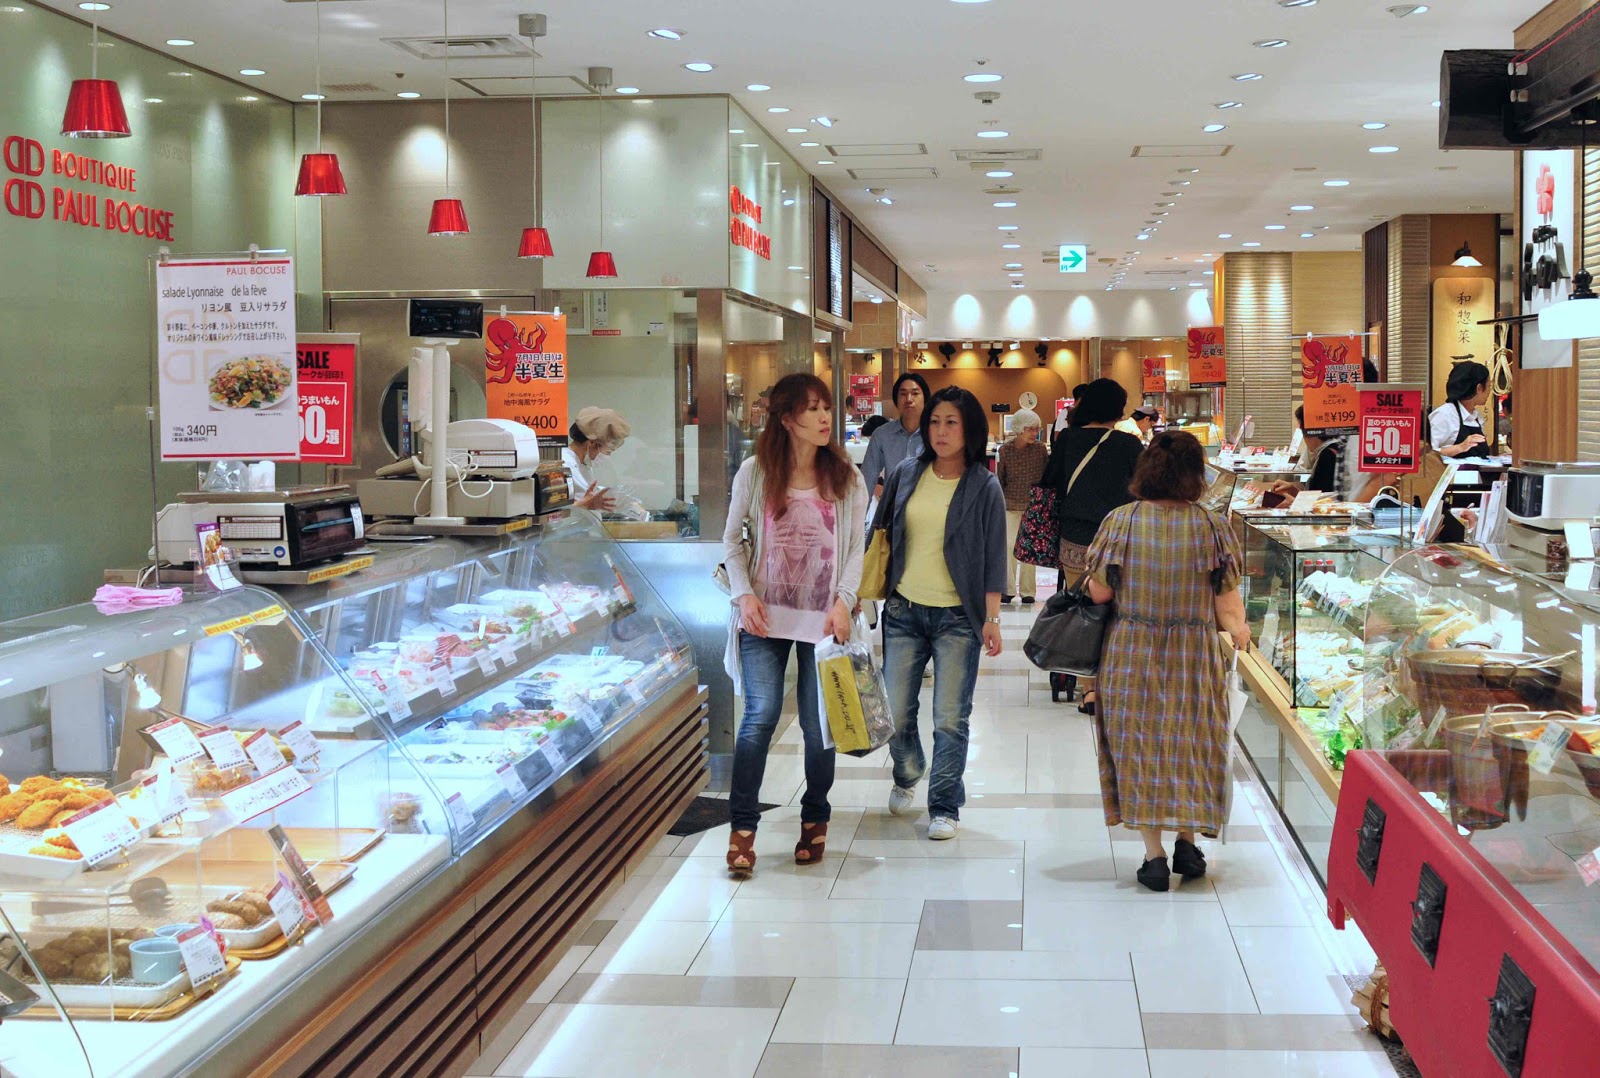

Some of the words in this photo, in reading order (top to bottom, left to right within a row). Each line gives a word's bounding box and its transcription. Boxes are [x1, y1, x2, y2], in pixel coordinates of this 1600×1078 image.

[52, 149, 137, 192] BOUTIQUE
[53, 186, 101, 228] PAUL
[105, 198, 175, 242] BOCUSE
[226, 267, 247, 275] PAUL
[250, 266, 286, 275] BOCUSE
[162, 286, 186, 298] salade
[187, 285, 224, 300] Lyonnaise
[231, 285, 242, 297] de
[242, 285, 250, 296] la
[250, 284, 267, 296] fève
[201, 302, 232, 313] リヨン風
[240, 301, 288, 312] 豆入りサラダ
[296, 351, 330, 369] SALE
[516, 362, 565, 379] 半夏生
[1325, 371, 1363, 384] 半夏生
[298, 396, 340, 406] うまいもん
[1376, 393, 1404, 407] SALE
[522, 415, 558, 429] ¥400
[1330, 410, 1356, 422] ¥199
[1367, 419, 1412, 427] 夏のうまいもん
[187, 424, 217, 437] 340円
